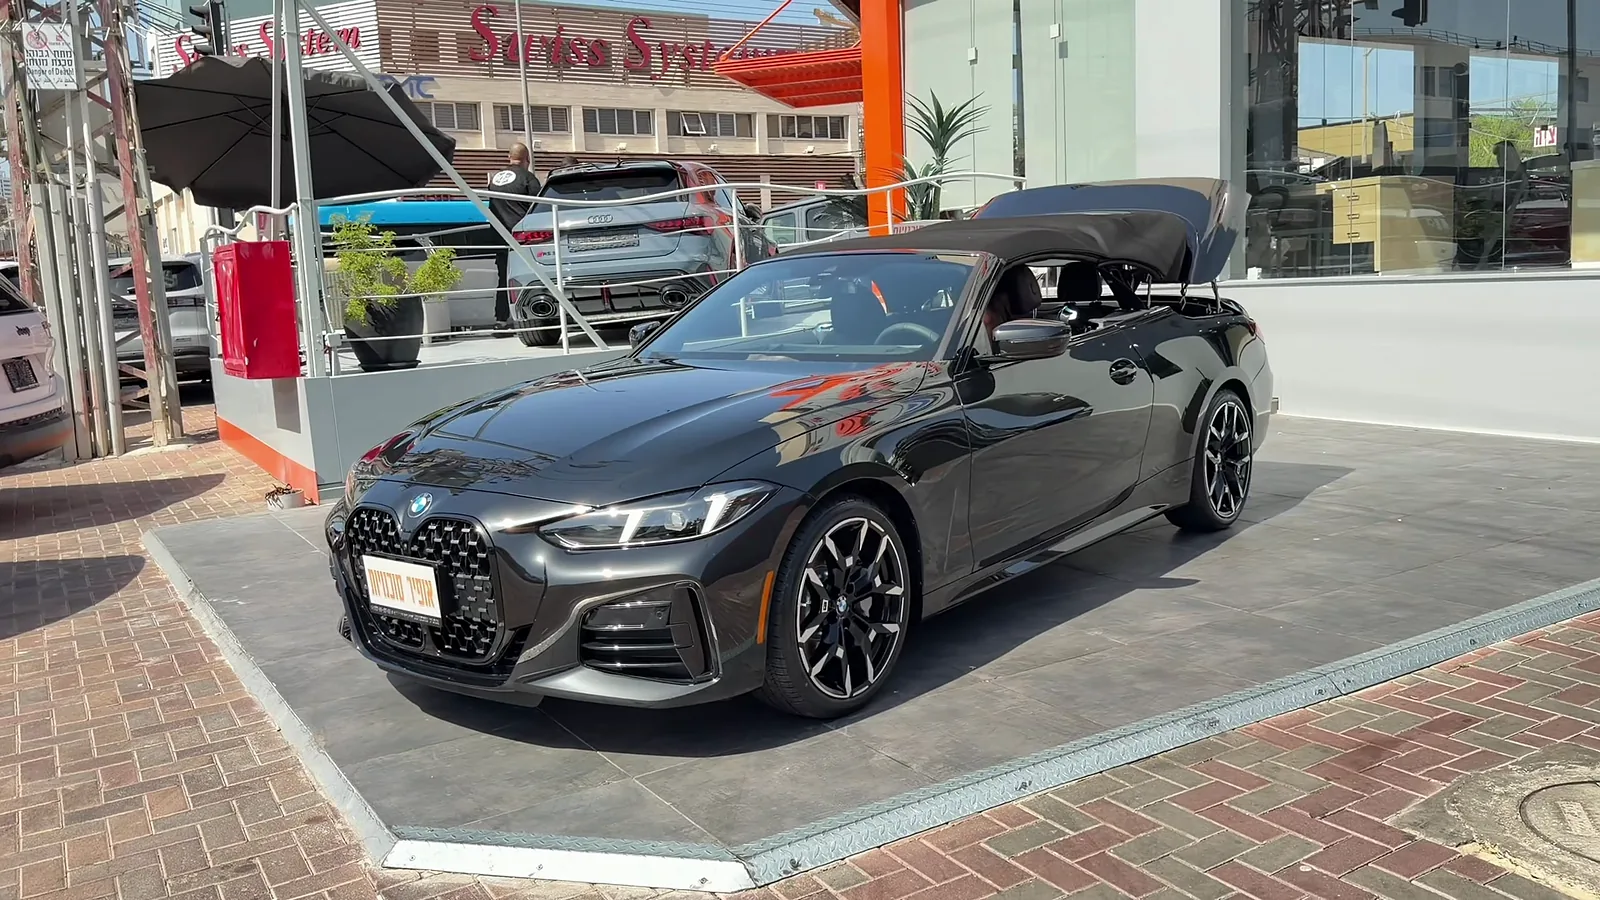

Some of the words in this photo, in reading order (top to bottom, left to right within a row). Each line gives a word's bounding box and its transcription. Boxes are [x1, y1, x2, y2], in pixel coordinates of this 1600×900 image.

[468, 4, 608, 66] Swiss
[48, 67, 55, 75] of
[406, 576, 435, 608] אופיר
